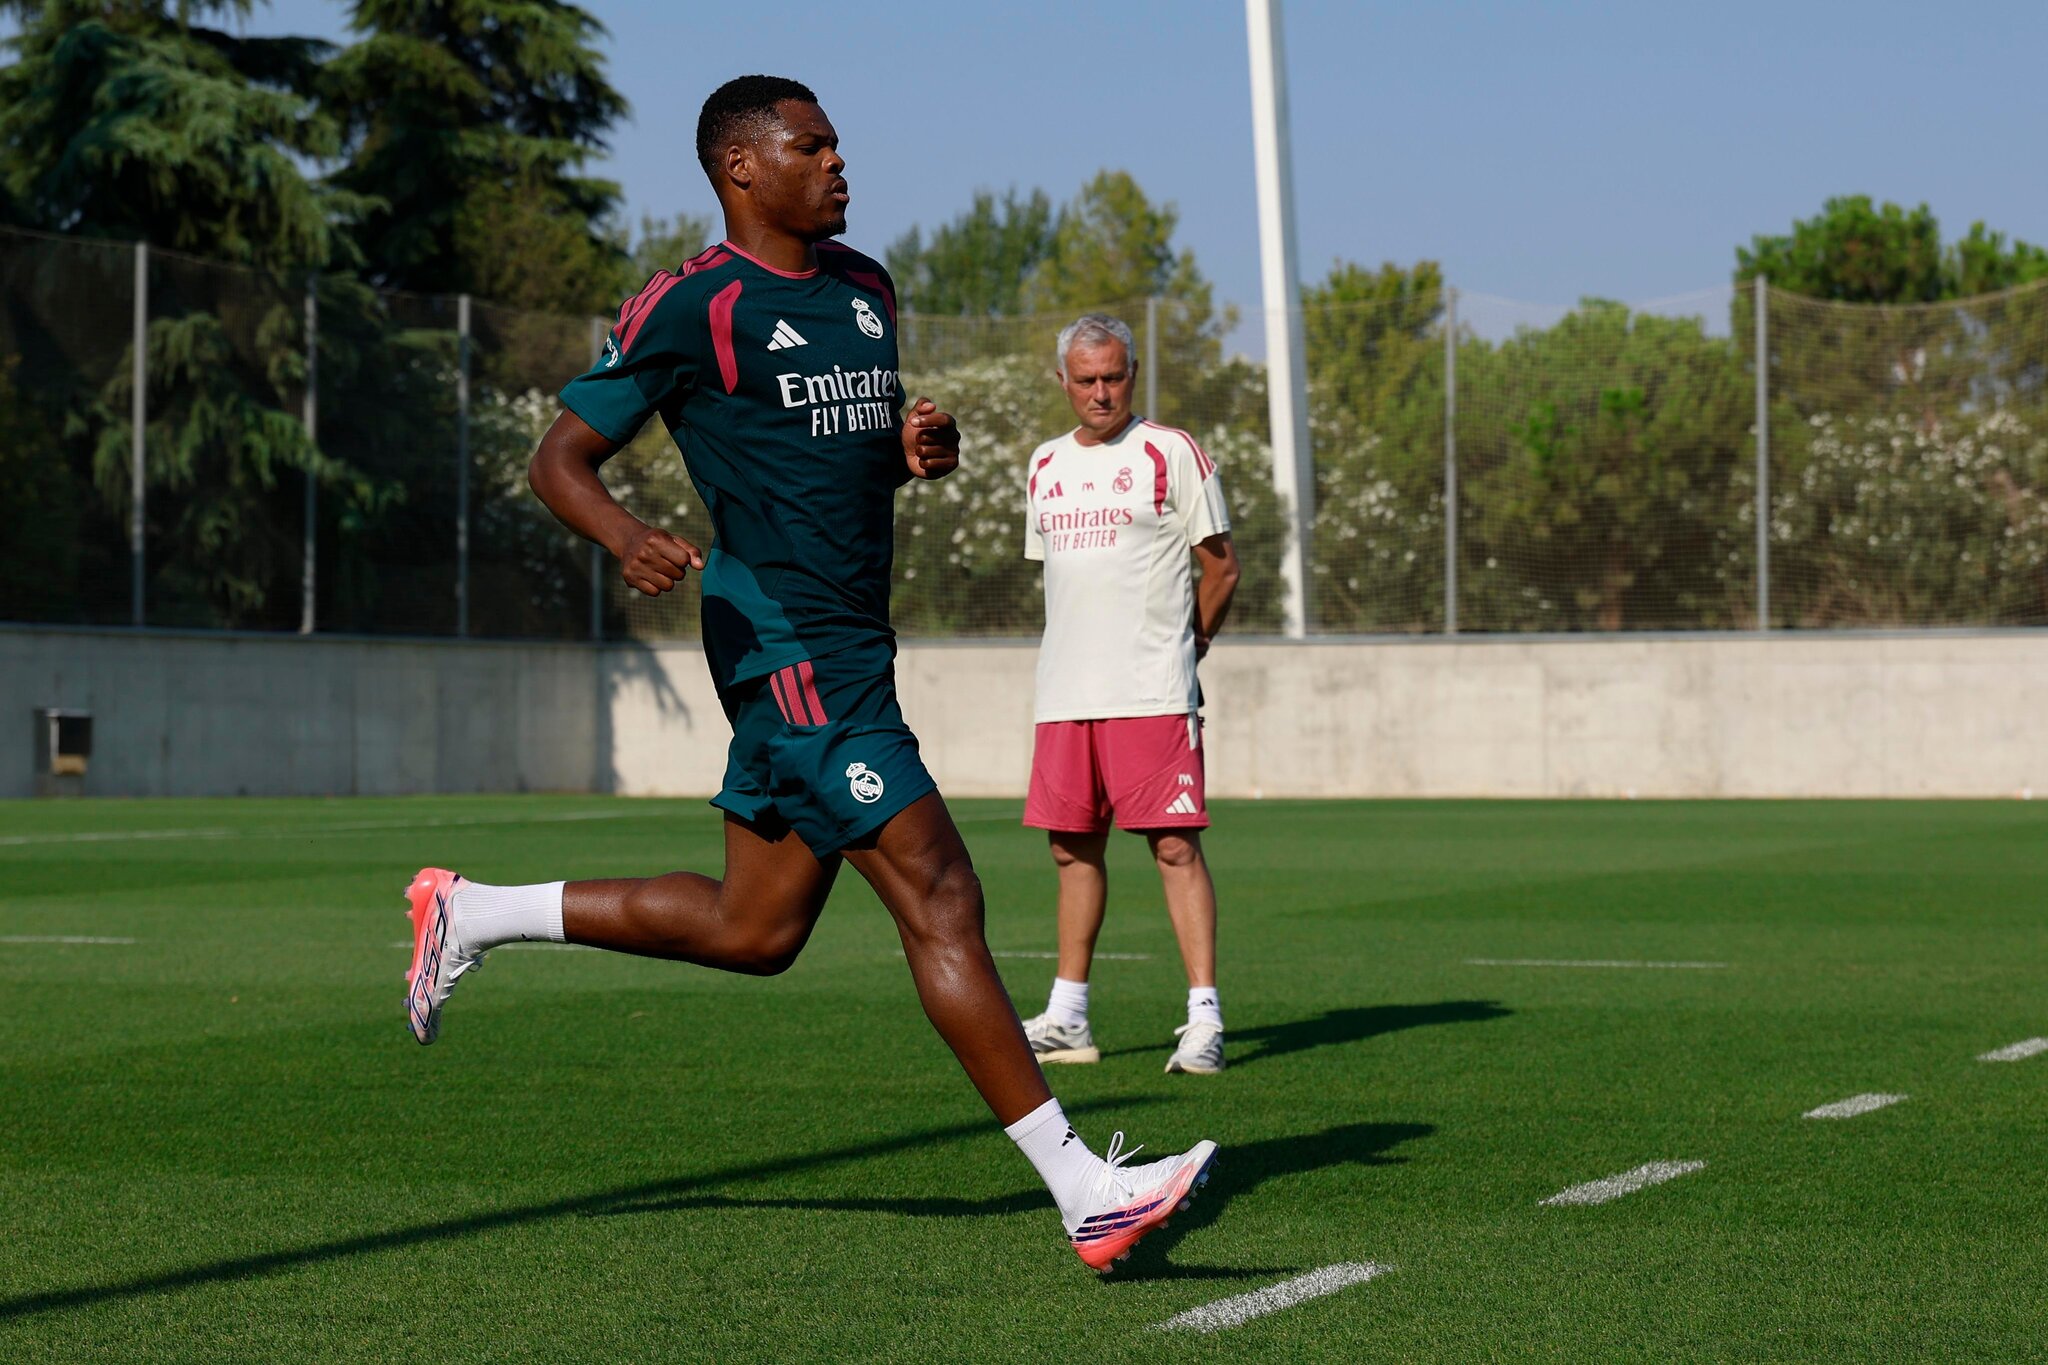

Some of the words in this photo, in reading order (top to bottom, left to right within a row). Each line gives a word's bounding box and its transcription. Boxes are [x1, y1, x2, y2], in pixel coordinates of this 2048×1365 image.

[811, 405, 840, 437] FLY
[846, 402, 893, 432] BETTER
[1040, 507, 1133, 534] Emirates
[1052, 534, 1070, 553] FLY
[1073, 529, 1117, 550] BETTER
